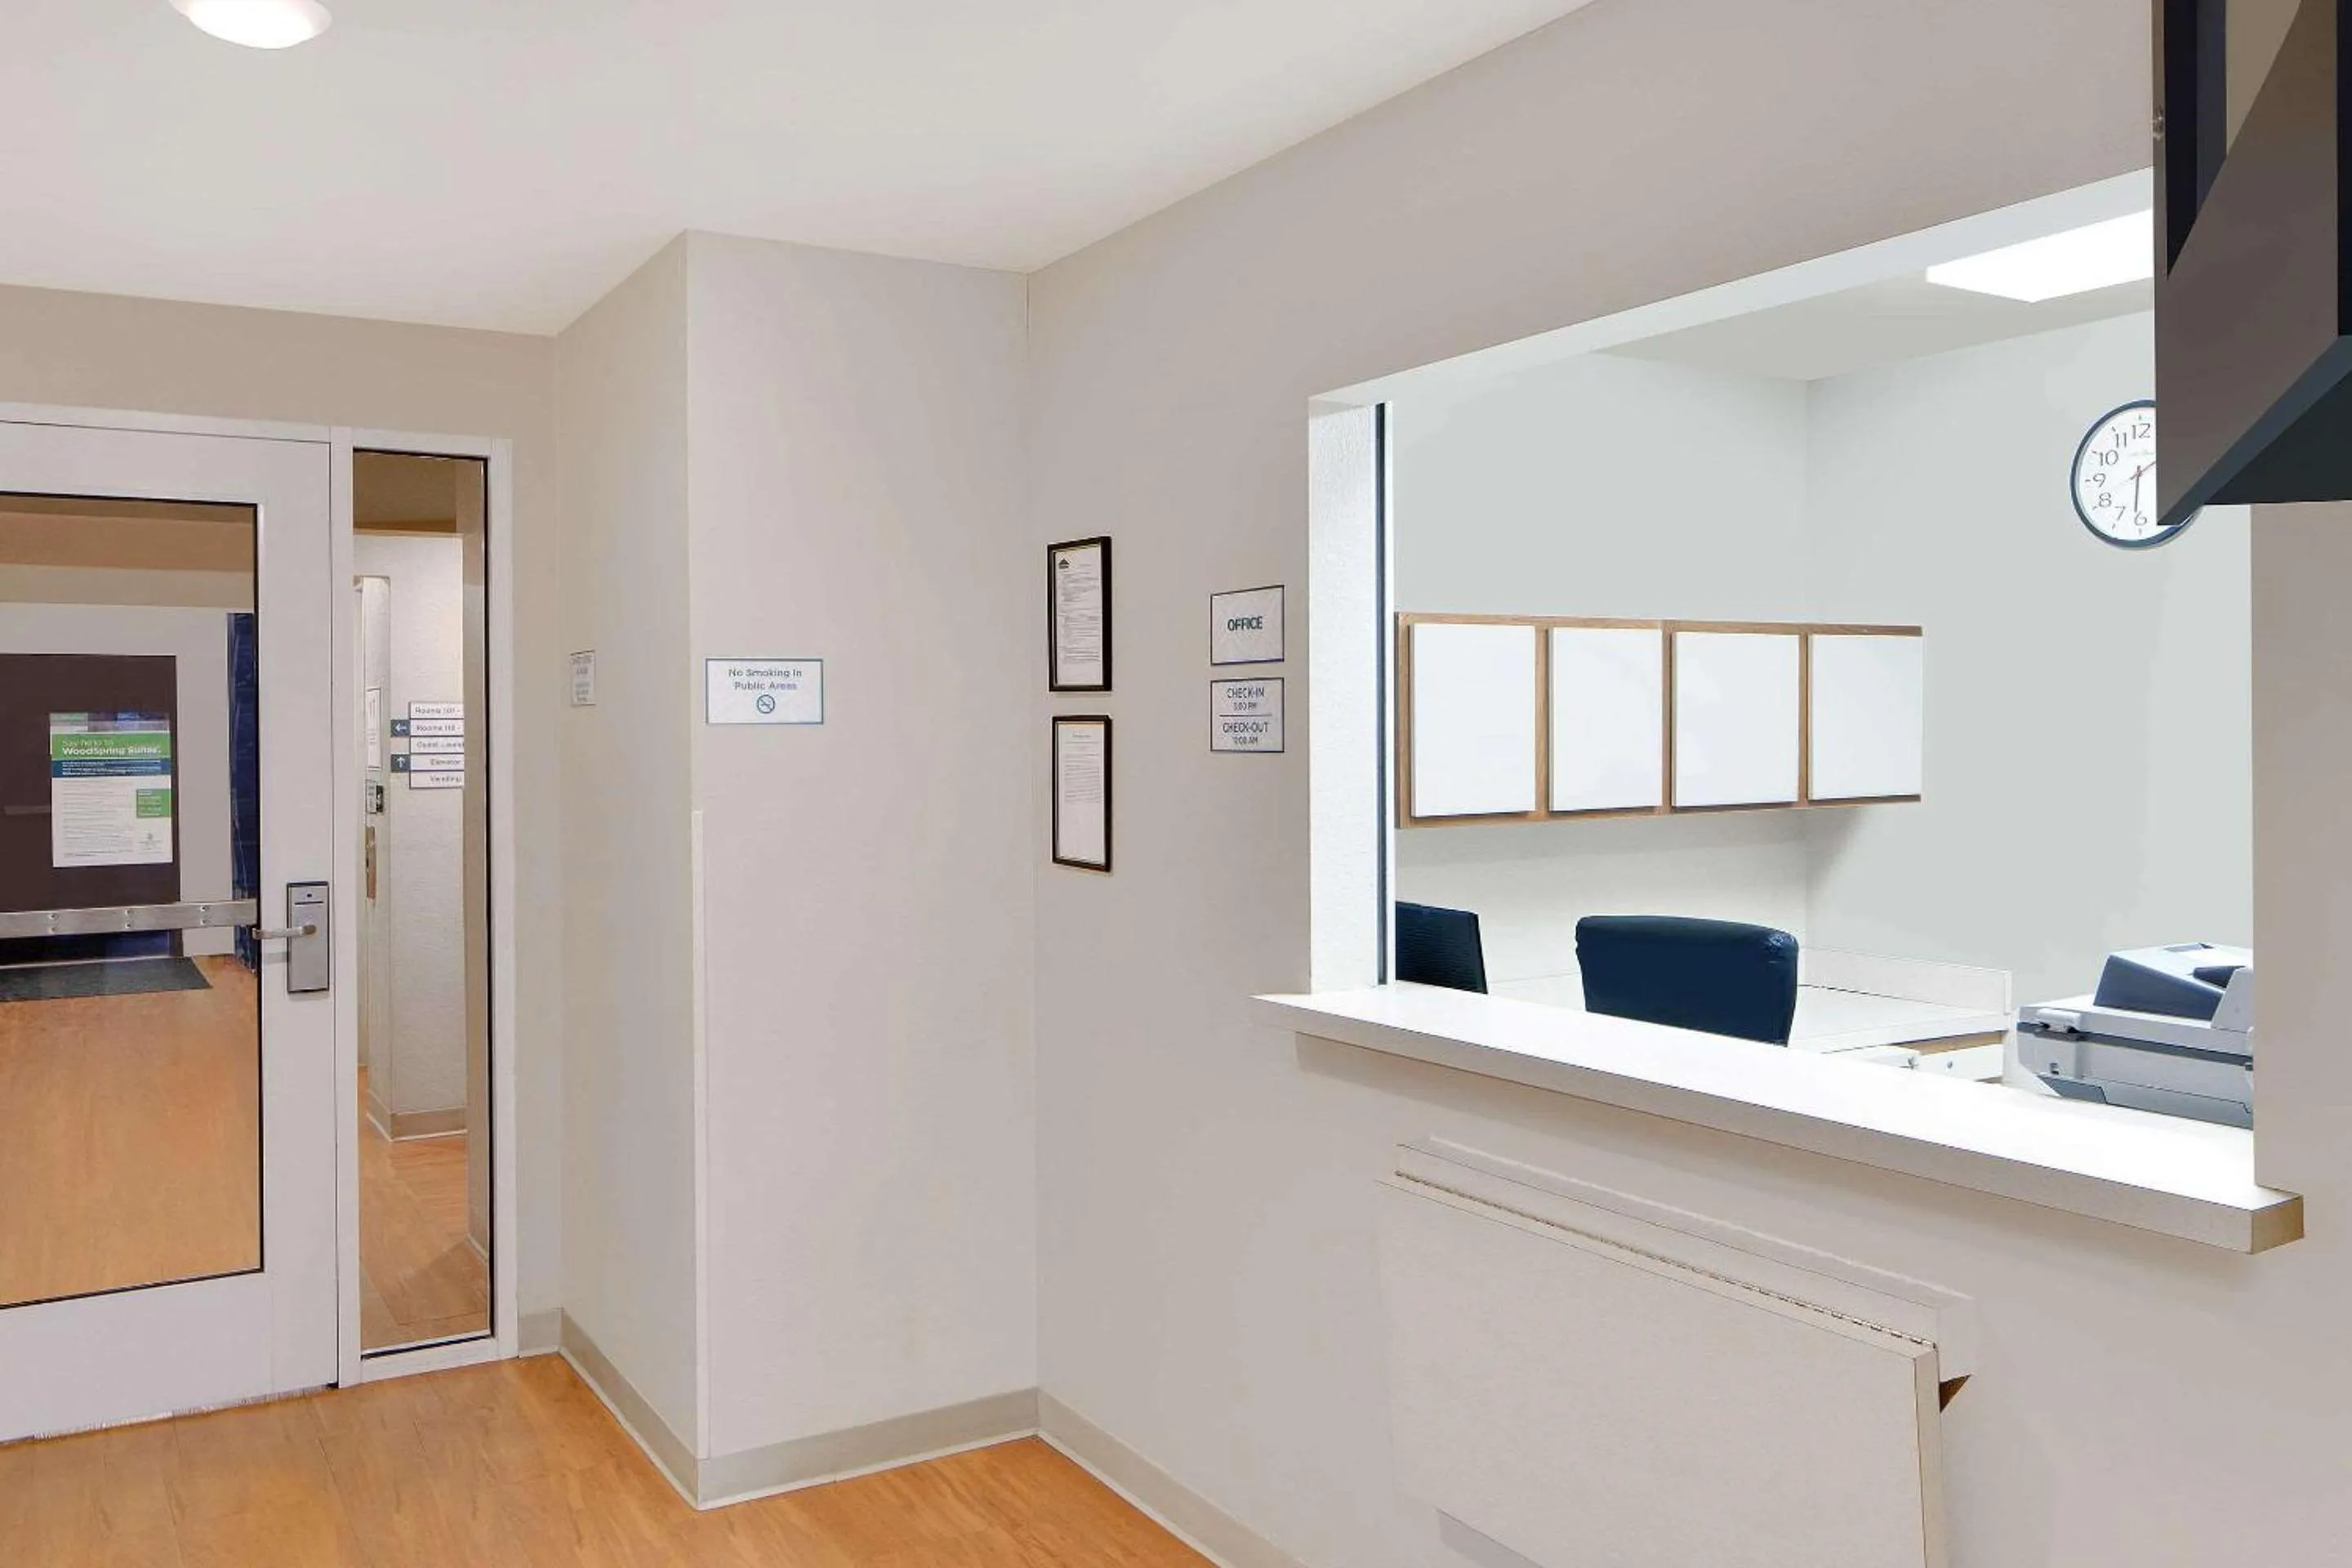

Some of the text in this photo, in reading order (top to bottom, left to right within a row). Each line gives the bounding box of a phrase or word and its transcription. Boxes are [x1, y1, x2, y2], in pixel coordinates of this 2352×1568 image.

[2132, 423, 2150, 439] 12
[2116, 432, 2127, 448] 11
[2099, 449, 2118, 466] 10
[2092, 473, 2106, 488] 9
[2099, 492, 2111, 507] 8
[2114, 506, 2125, 521] 7
[2134, 510, 2147, 526] 6
[1227, 616, 1263, 631] OFFICE
[728, 668, 802, 678] No Smoking In
[735, 681, 798, 691] Public Areas
[1227, 687, 1265, 698] CHECK-IN
[415, 706, 441, 714] Rooms
[1223, 721, 1268, 733] CHECK-OUT
[62, 746, 126, 756] WoodSpring
